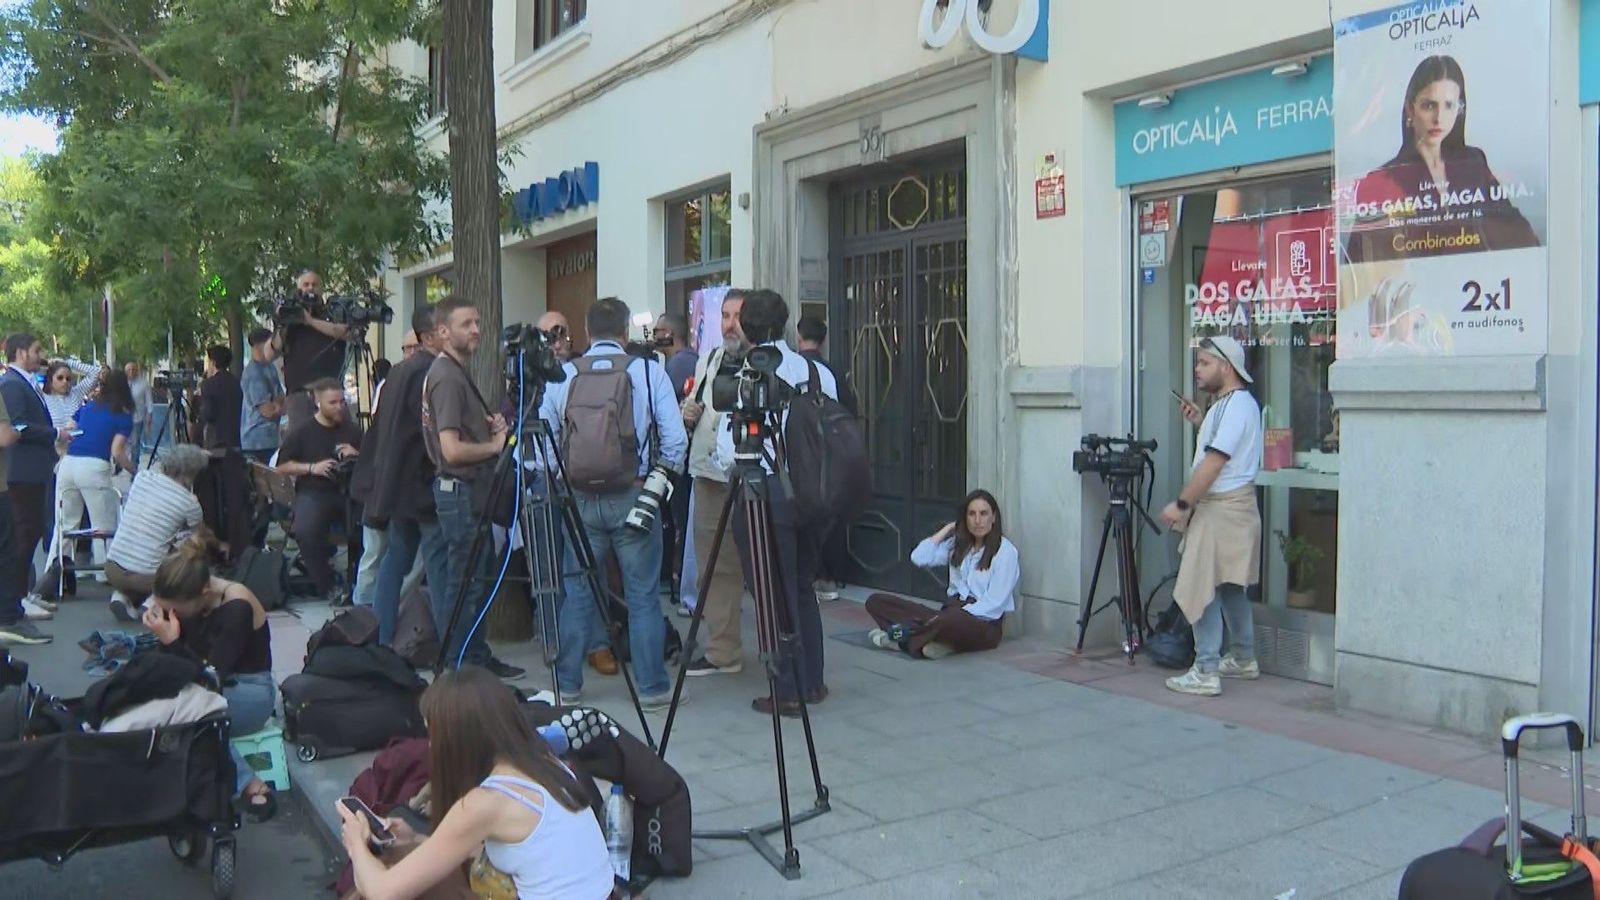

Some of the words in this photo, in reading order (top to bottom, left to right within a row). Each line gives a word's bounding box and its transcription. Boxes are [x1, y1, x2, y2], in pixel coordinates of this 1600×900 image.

[1414, 34, 1453, 51] FERRAZ
[1381, 195, 1437, 215] GAFAS,
[1440, 187, 1486, 208] PAGA
[1392, 226, 1481, 252] Combinados
[1184, 281, 1230, 305] DOS
[1235, 275, 1321, 304] GAFAS,
[1461, 277, 1511, 313] 2x1
[1190, 304, 1249, 328] PAGA
[1254, 301, 1314, 325] UNA.
[1450, 320, 1464, 329] en
